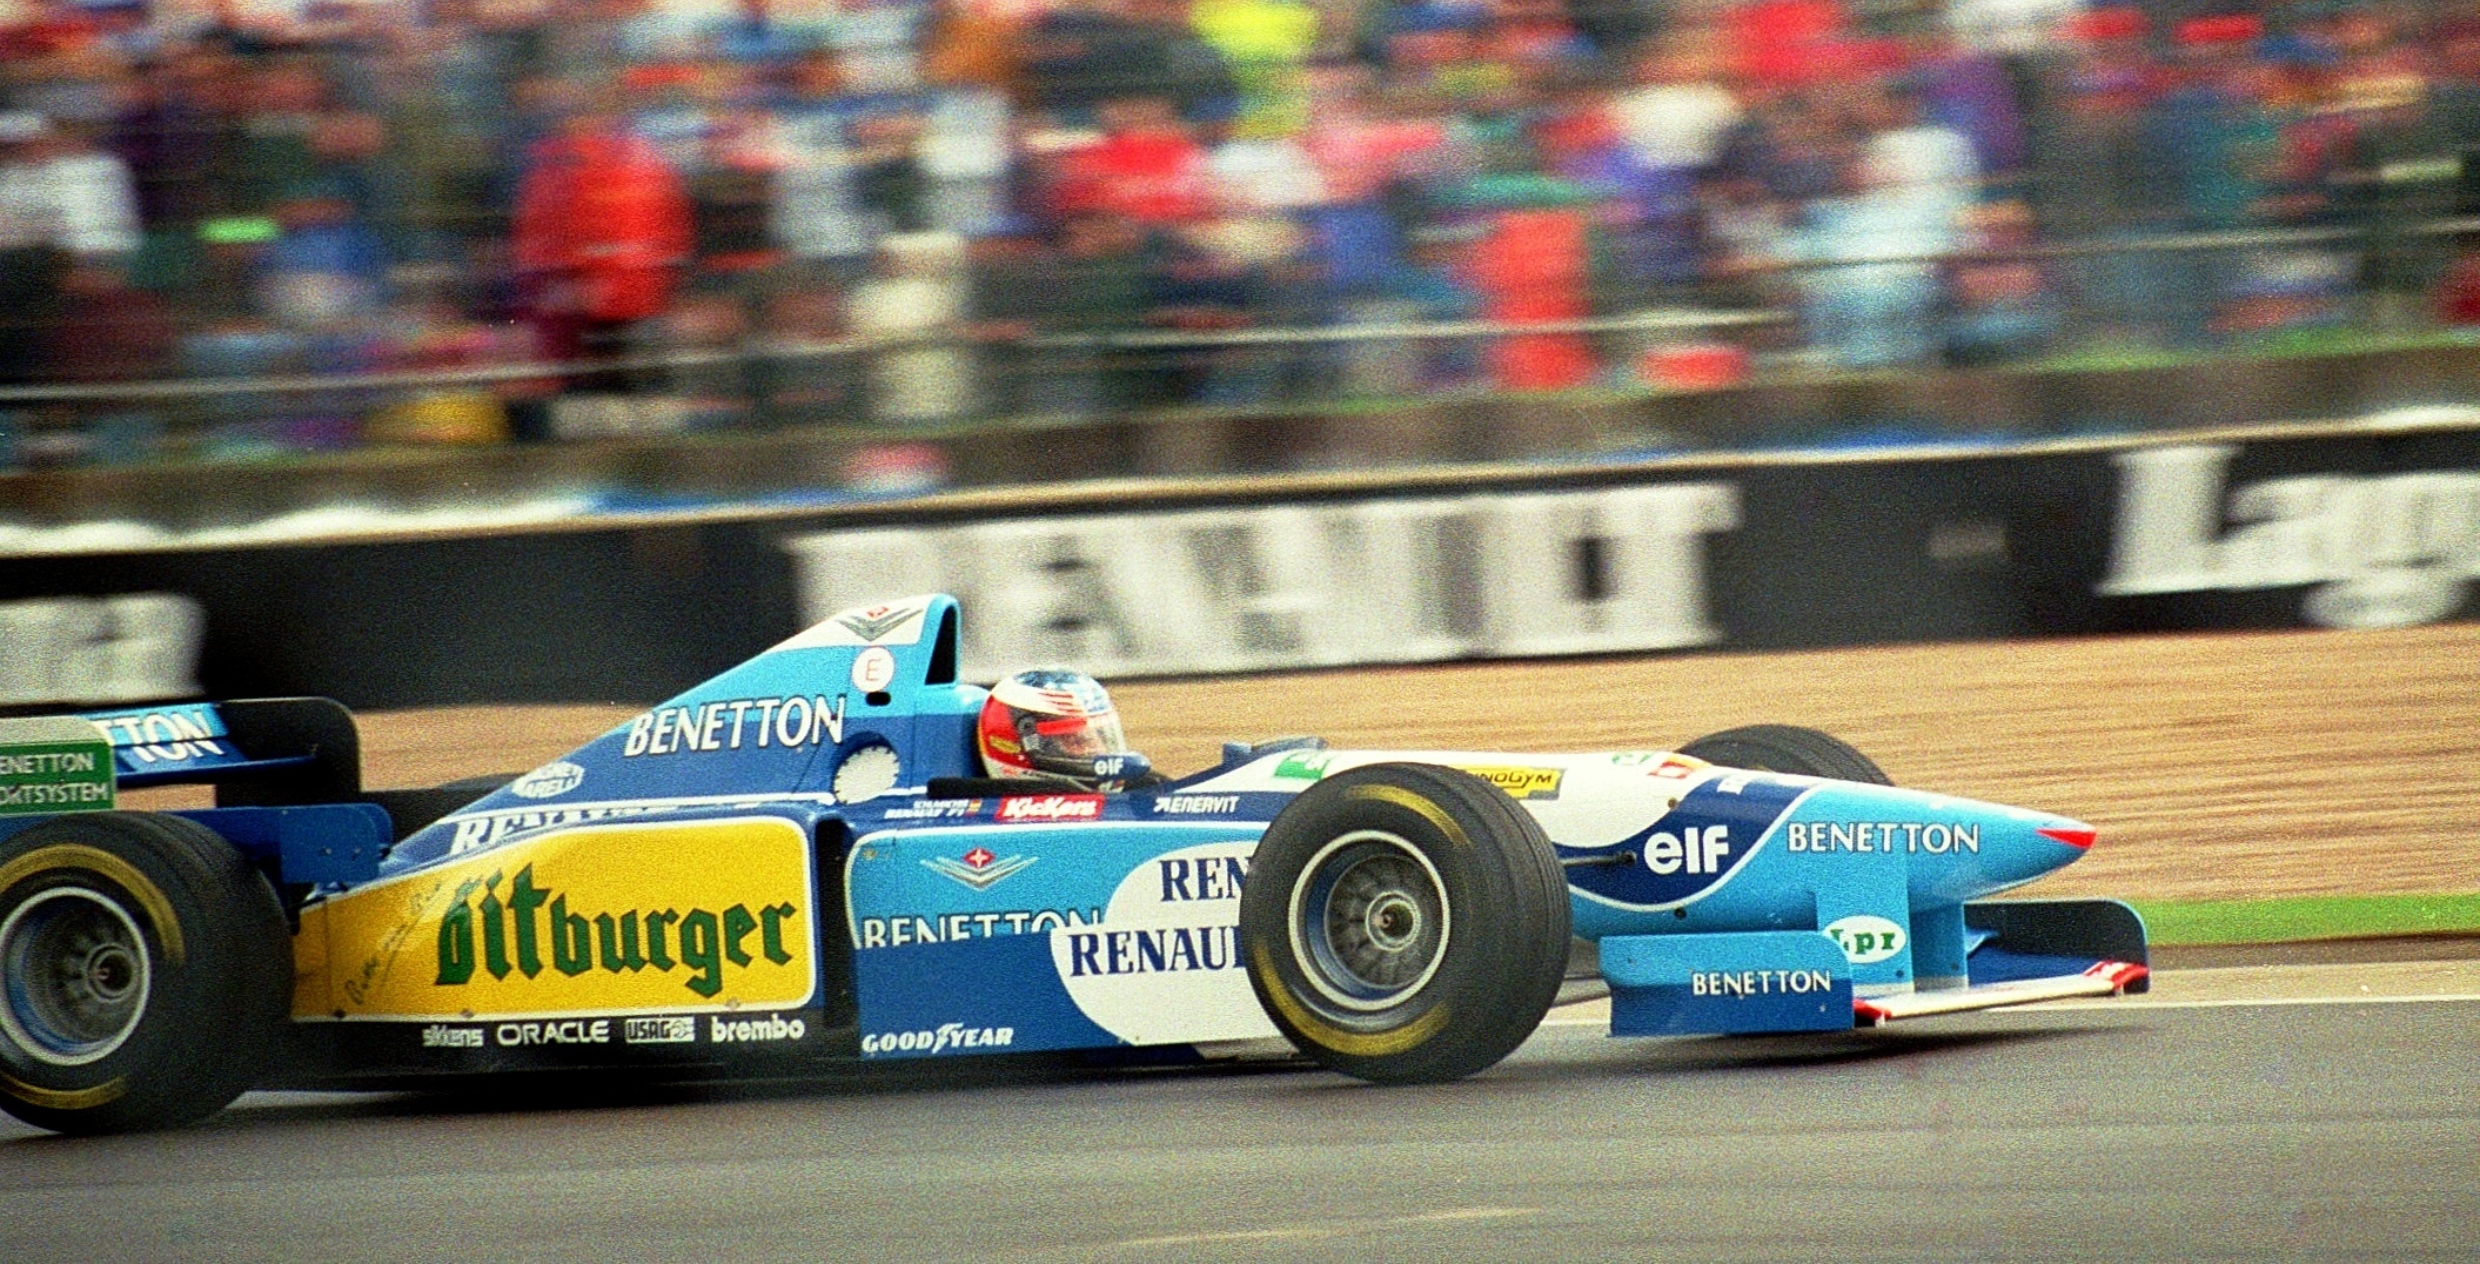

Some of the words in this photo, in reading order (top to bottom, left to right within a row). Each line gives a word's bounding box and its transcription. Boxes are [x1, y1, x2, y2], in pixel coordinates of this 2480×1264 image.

[865, 658, 882, 682] E
[624, 693, 846, 757] BENETTON
[1093, 757, 1124, 776] elf
[1644, 825, 1730, 875] elf
[1787, 823, 1980, 854] BENETTON
[1692, 969, 1832, 997] BENETTON
[497, 1020, 610, 1046] ORACLE
[711, 1013, 805, 1043] brembo
